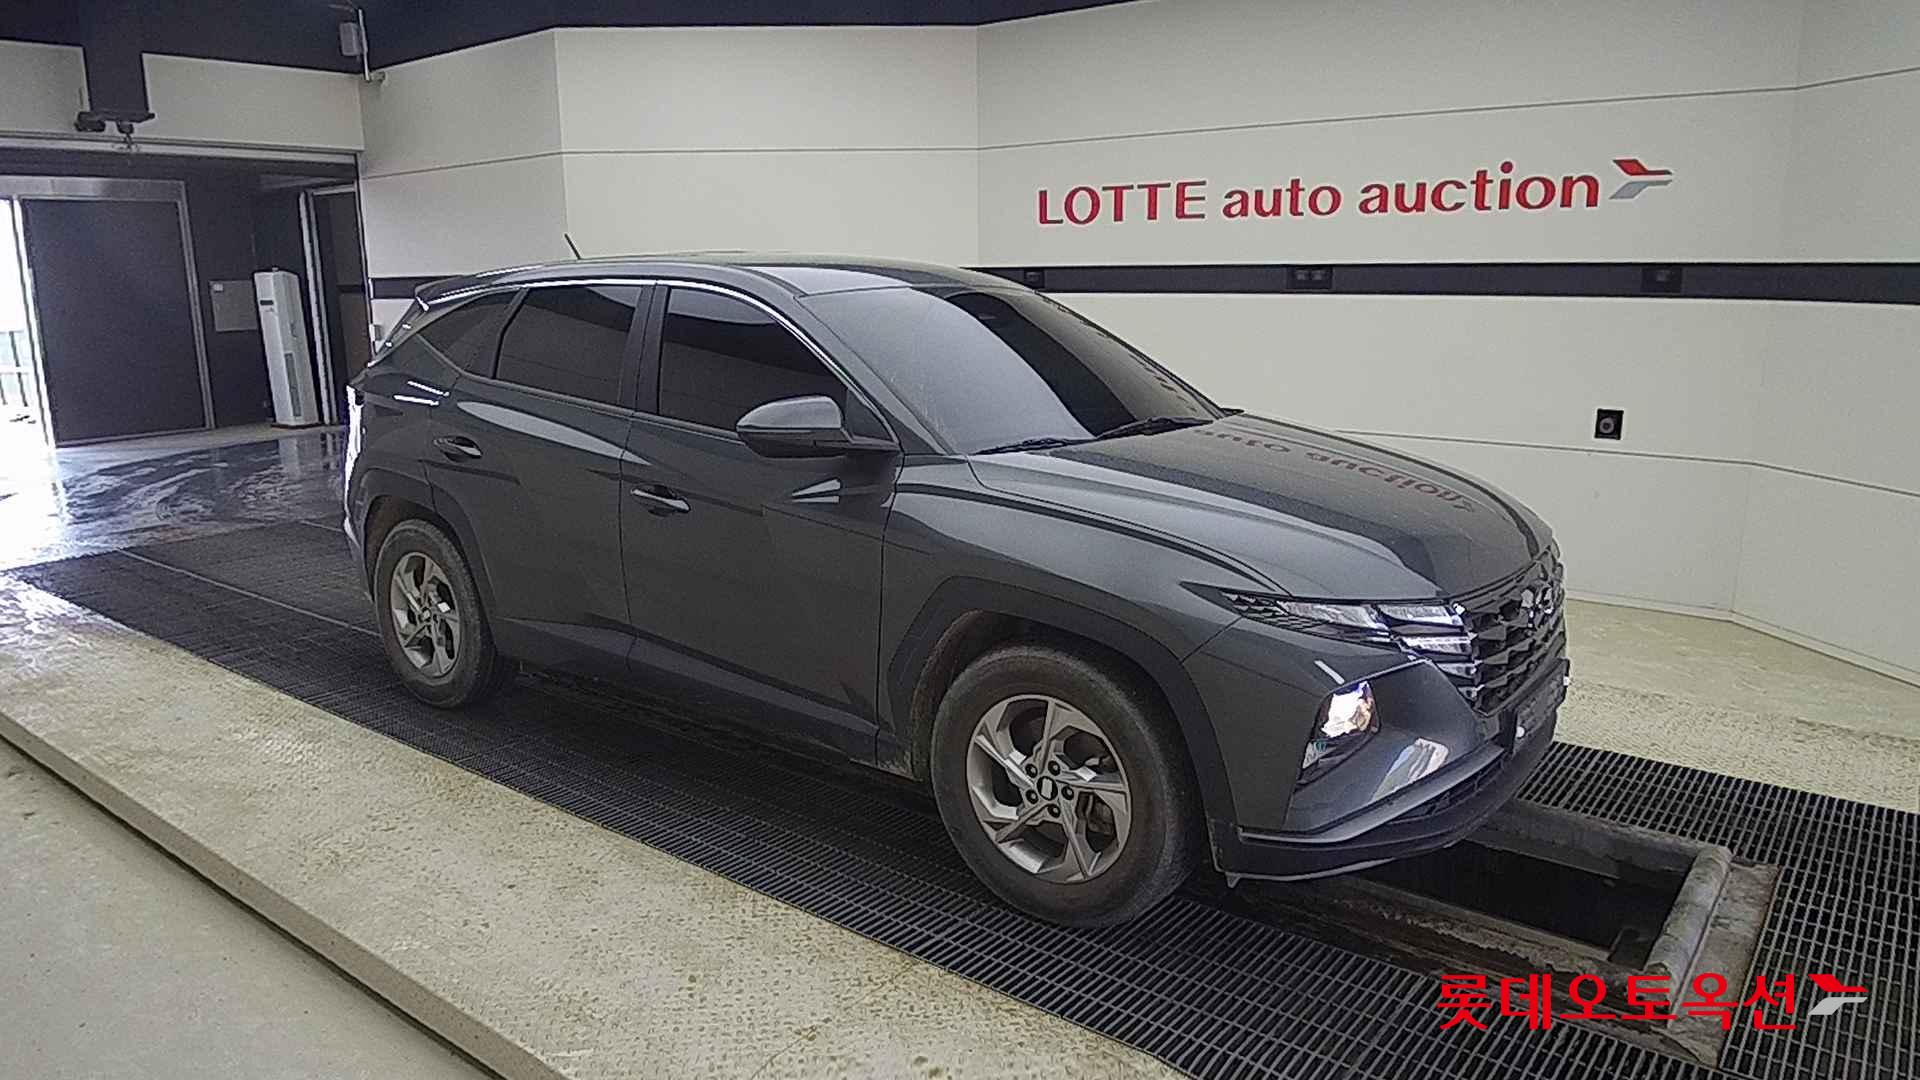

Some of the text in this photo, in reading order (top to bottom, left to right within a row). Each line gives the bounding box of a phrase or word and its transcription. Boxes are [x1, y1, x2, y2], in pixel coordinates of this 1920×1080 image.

[1039, 161, 1600, 225] LOTTE auto auction
